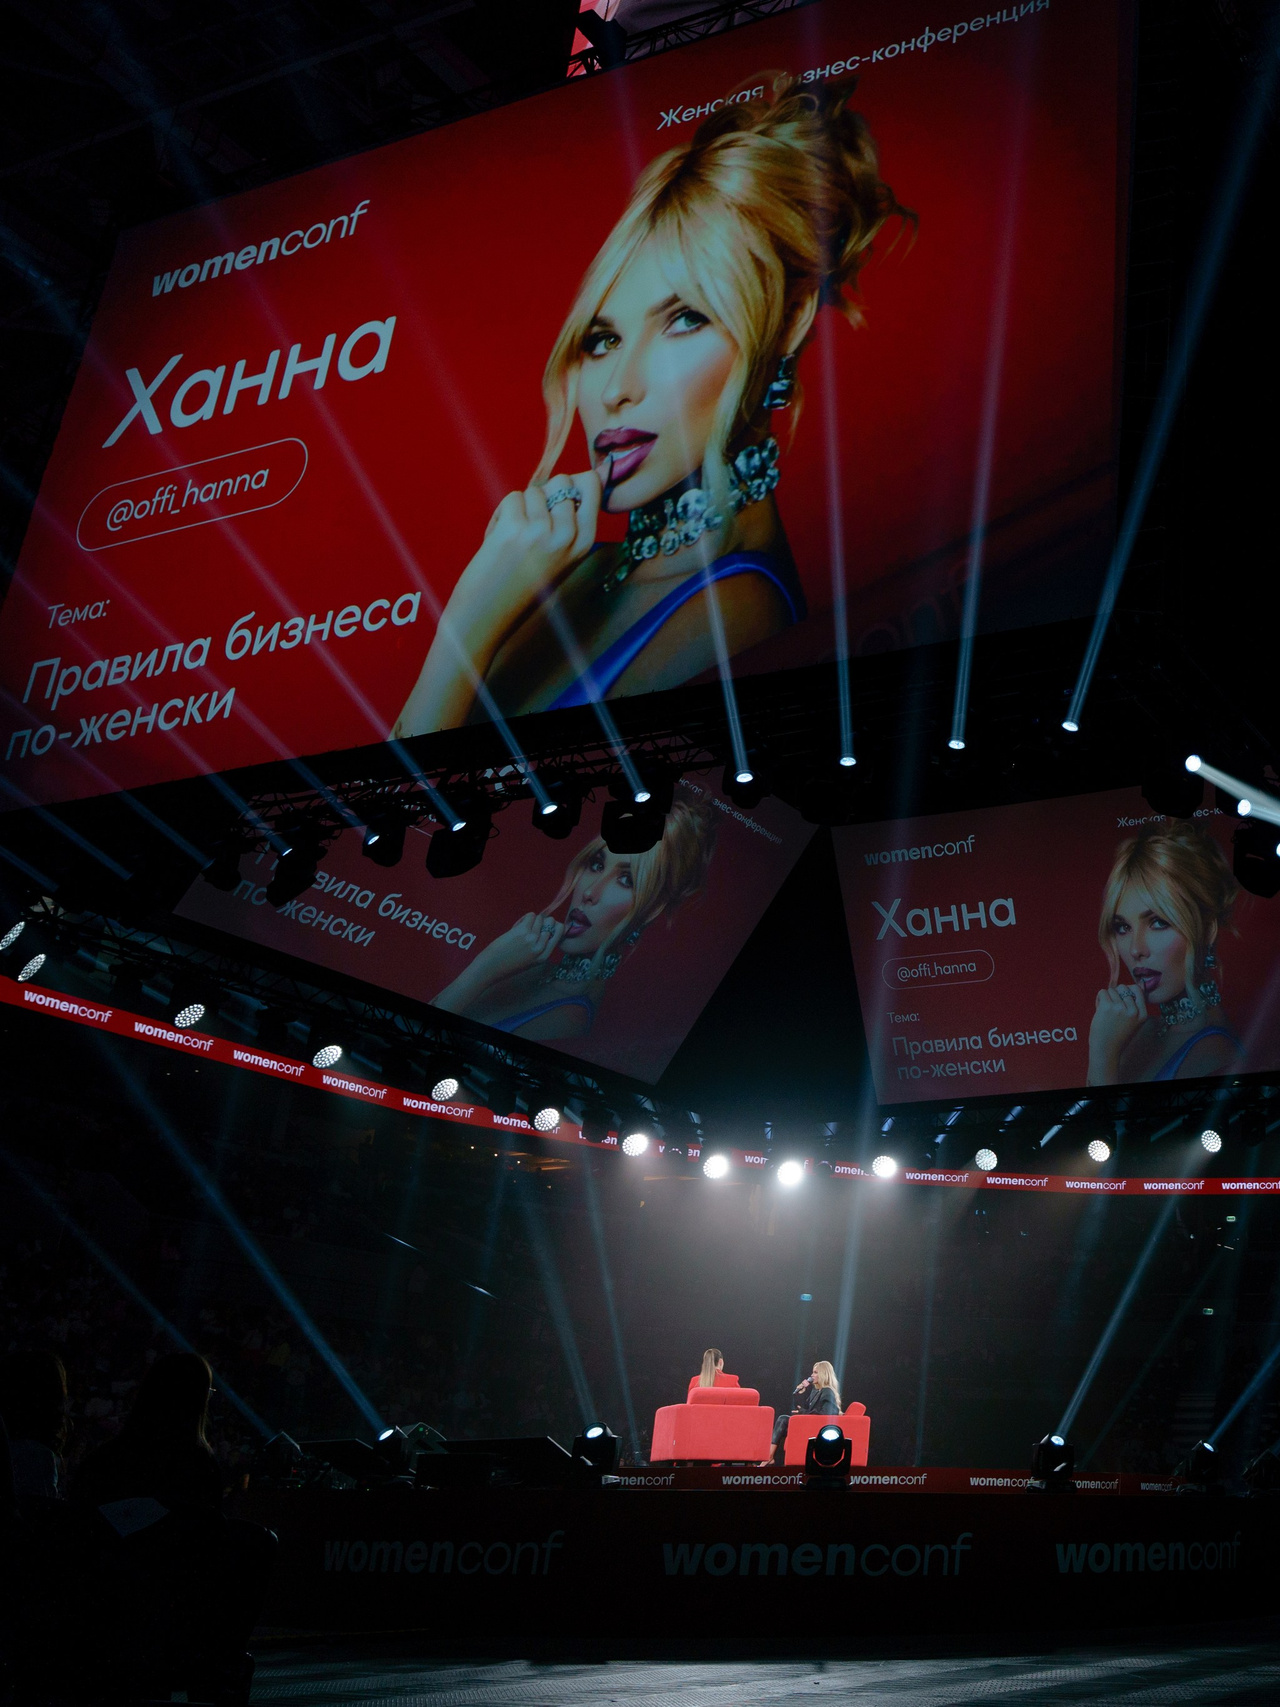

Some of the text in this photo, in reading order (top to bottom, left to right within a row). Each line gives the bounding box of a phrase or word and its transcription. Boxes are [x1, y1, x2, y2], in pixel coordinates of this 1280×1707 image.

[151, 200, 371, 297] womenconf
[102, 315, 397, 449] Ханна
[106, 468, 269, 531] @offi_hanna
[47, 599, 109, 630] Тема:
[22, 591, 423, 703] Правила бизнеса
[4, 687, 236, 761] по-женски
[711, 796, 783, 845] знес-конференция
[864, 835, 976, 867] womenconf
[233, 879, 376, 947] поженски
[377, 893, 476, 950] бизнеса
[871, 896, 1017, 941] Ханна
[897, 959, 977, 982] @offi_hanna
[887, 1010, 921, 1024] Тема:
[892, 1024, 1078, 1059] Правила бизнеса
[24, 989, 112, 1023] womenconf
[134, 1020, 214, 1052] womenconf
[233, 1049, 305, 1077] womenconf
[322, 1073, 387, 1100] womenconf
[403, 1096, 474, 1119] womenconf
[905, 1171, 970, 1183] womenconf
[986, 1176, 1048, 1188] womenconf
[1065, 1179, 1127, 1190] womenconf
[1143, 1180, 1205, 1191] womenconf
[897, 1057, 1006, 1080] по-женски
[602, 1473, 675, 1486] menconf
[722, 1473, 802, 1485] womenconf
[850, 1473, 927, 1485] womenconf
[324, 1530, 1243, 1577] womenconf womenconf womenconf
